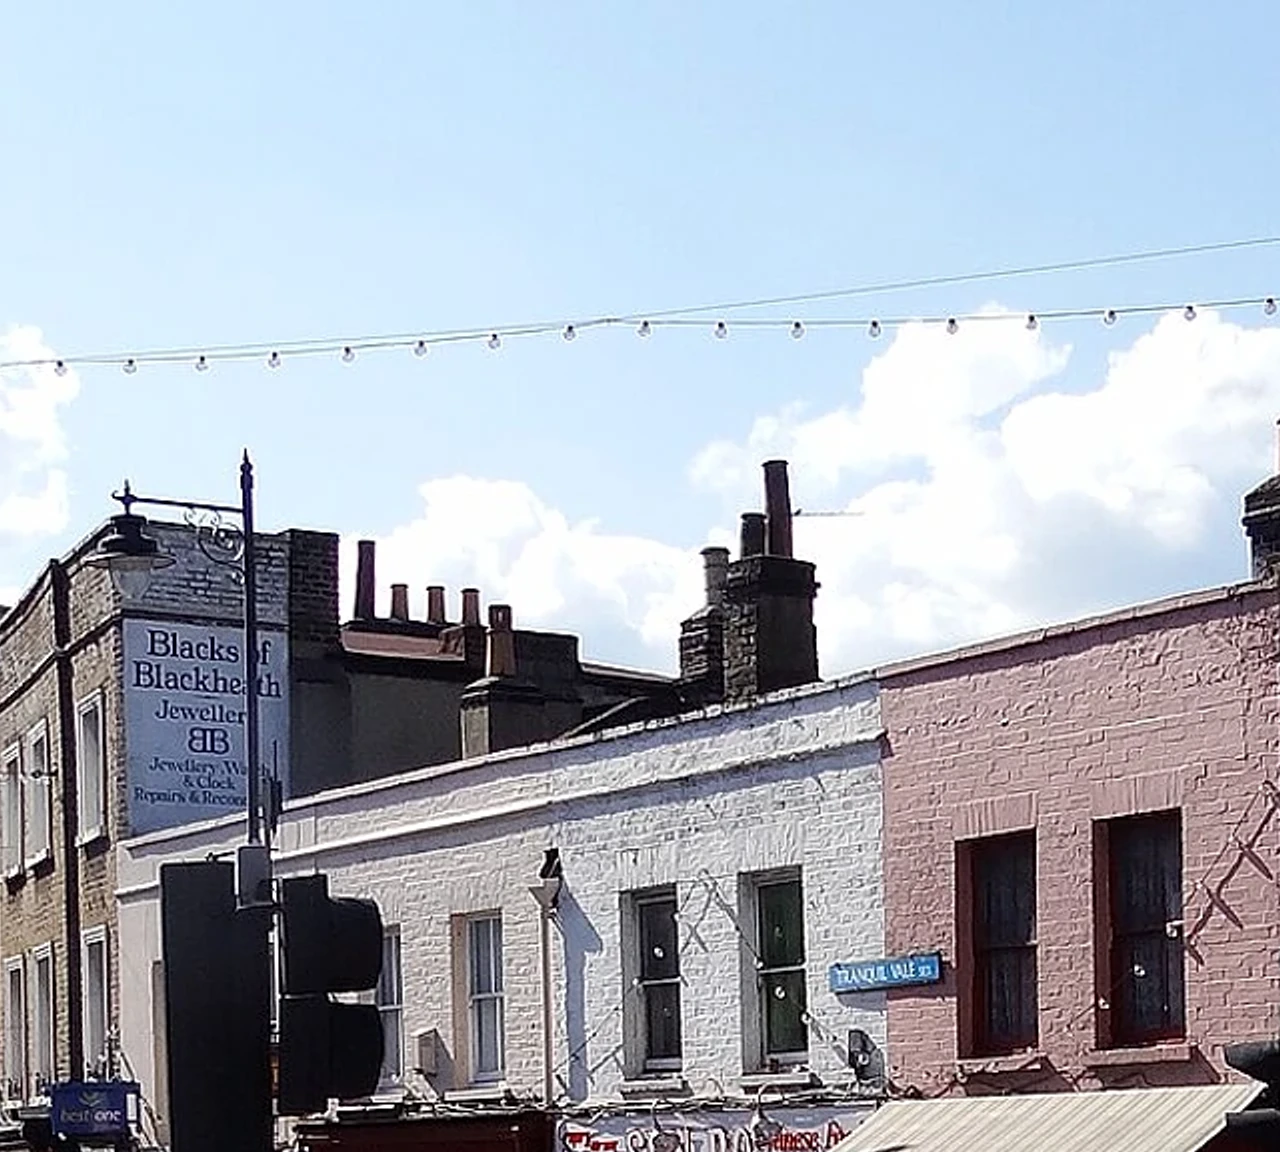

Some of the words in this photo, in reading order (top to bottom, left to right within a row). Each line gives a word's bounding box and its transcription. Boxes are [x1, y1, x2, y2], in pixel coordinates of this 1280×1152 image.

[146, 629, 239, 664] Blacks
[196, 773, 236, 790] Clock
[837, 965, 887, 986] TRANQUIL
[889, 961, 916, 980] VALE
